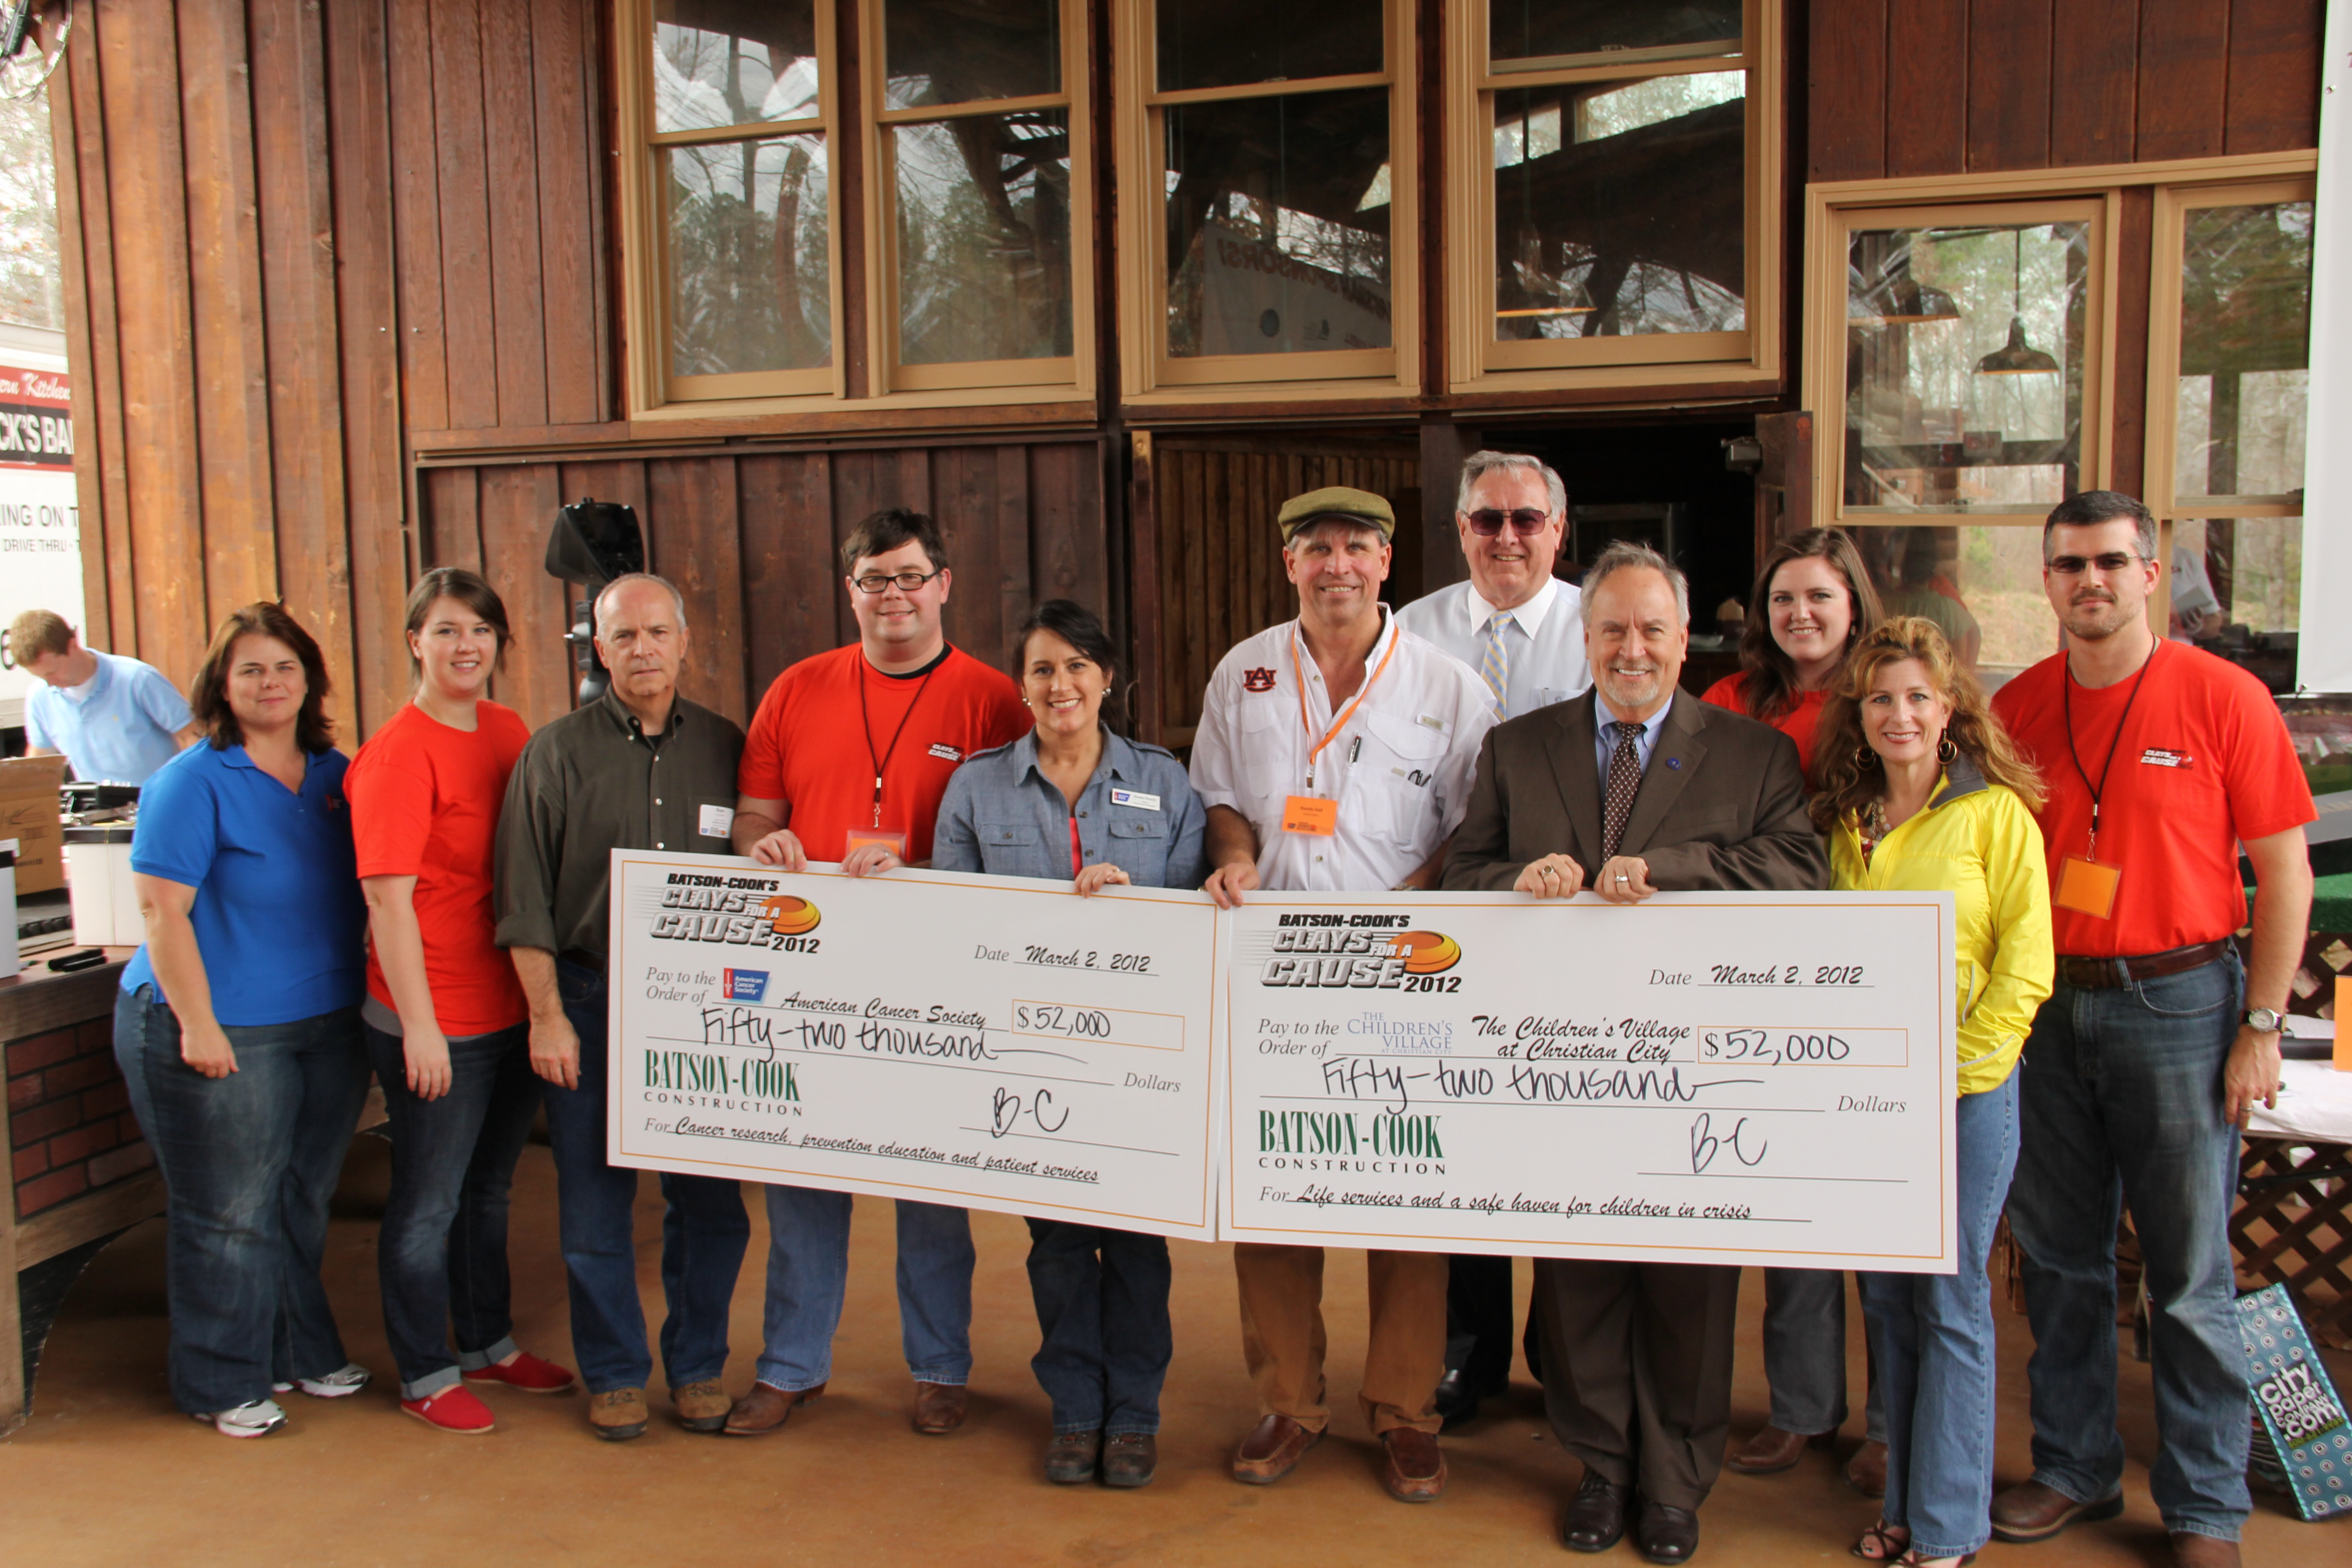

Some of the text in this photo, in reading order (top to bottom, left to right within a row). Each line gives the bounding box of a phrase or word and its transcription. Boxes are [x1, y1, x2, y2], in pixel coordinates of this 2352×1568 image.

[21, 372, 71, 401] Kitchen
[0, 504, 34, 526] ING
[40, 505, 65, 527] ON
[4, 539, 67, 552] DRIVE THRU
[667, 873, 780, 892] BATSON-COOK'S
[661, 887, 748, 912] CLAYS
[743, 905, 781, 919] FOR A
[650, 911, 774, 947] CAUSE
[1278, 914, 1411, 927] BATSON-COOK'S
[771, 936, 820, 954] 2012
[1272, 928, 1373, 953] CLAYS
[1369, 944, 1412, 957] FOR A
[975, 945, 1009, 962] Date
[1025, 945, 1079, 966] March
[1110, 954, 1151, 972] 2012
[646, 967, 715, 985] Pay to the
[735, 975, 764, 984] American
[1260, 957, 1406, 989] CAUSE
[1403, 976, 1462, 993] 2012
[1649, 970, 1692, 986] Date
[1711, 965, 1777, 985] March
[1814, 966, 1863, 985] 2012
[647, 985, 986, 1029] Order of American Cancer Society
[1362, 1012, 1384, 1021] THE
[701, 1007, 998, 1064] Fifty-two thousand
[1258, 1015, 1690, 1040] Pay to the The Children's Village
[1347, 1019, 1452, 1036] CHILDREN'S
[1259, 1038, 1671, 1064] Order of at Christian City
[1382, 1035, 1452, 1049] VILLAGE
[645, 1049, 802, 1102] BATSON-COOK
[1124, 1073, 1181, 1093] Dollars
[1322, 1056, 1697, 1115] Fifty-two thousand
[645, 1092, 803, 1117] CONSTRUCTION
[1837, 1095, 1907, 1114] Dollars
[1258, 1109, 1445, 1158] BATSON-COOK
[645, 1116, 1098, 1181] For Cancer research, prevention education and patient services
[1259, 1157, 1446, 1175] CONSTRUCTION
[1259, 1184, 1752, 1220] For Life services and a safe haven for children in crisis
[2259, 1362, 2311, 1405] city
[2268, 1381, 2323, 1421] paper
[2276, 1393, 2331, 1429] COMPANY
